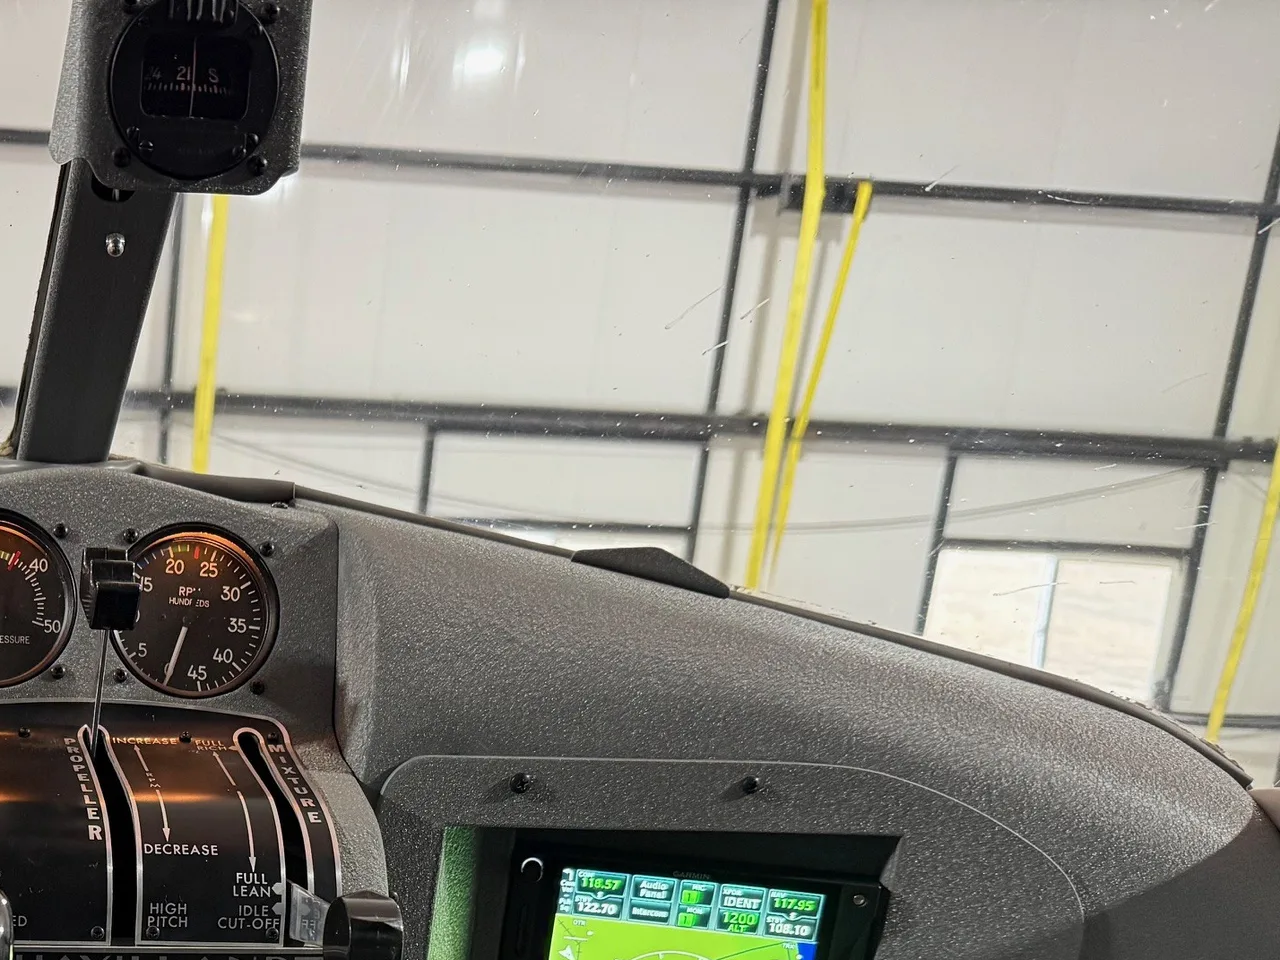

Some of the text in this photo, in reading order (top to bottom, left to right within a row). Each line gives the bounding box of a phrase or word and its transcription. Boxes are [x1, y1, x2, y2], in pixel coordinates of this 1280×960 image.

[176, 67, 191, 80] 21
[29, 558, 48, 573] 40
[165, 559, 184, 573] 20
[200, 563, 218, 577] 25
[221, 587, 240, 601] 30
[44, 620, 61, 633] 50
[228, 619, 246, 633] 35
[213, 649, 233, 663] 40
[188, 666, 207, 680] 45
[112, 737, 177, 745] INCREASE
[64, 738, 102, 840] PROPELLER
[267, 744, 321, 823] MIXTURE
[144, 843, 218, 855] DECREASE
[236, 872, 268, 884] FULL
[581, 878, 620, 891] 118.57
[233, 885, 270, 897] LEAN
[149, 903, 187, 915] HIGH
[576, 902, 616, 915] 122.70
[723, 897, 760, 908] IDENT
[774, 898, 815, 911] 117.95
[238, 905, 269, 916] IDLE
[148, 916, 188, 928] PITCH
[218, 917, 280, 930] CUT-OFF
[722, 912, 756, 925] 1200
[727, 923, 746, 932] ALT
[769, 923, 809, 936] 108.10
